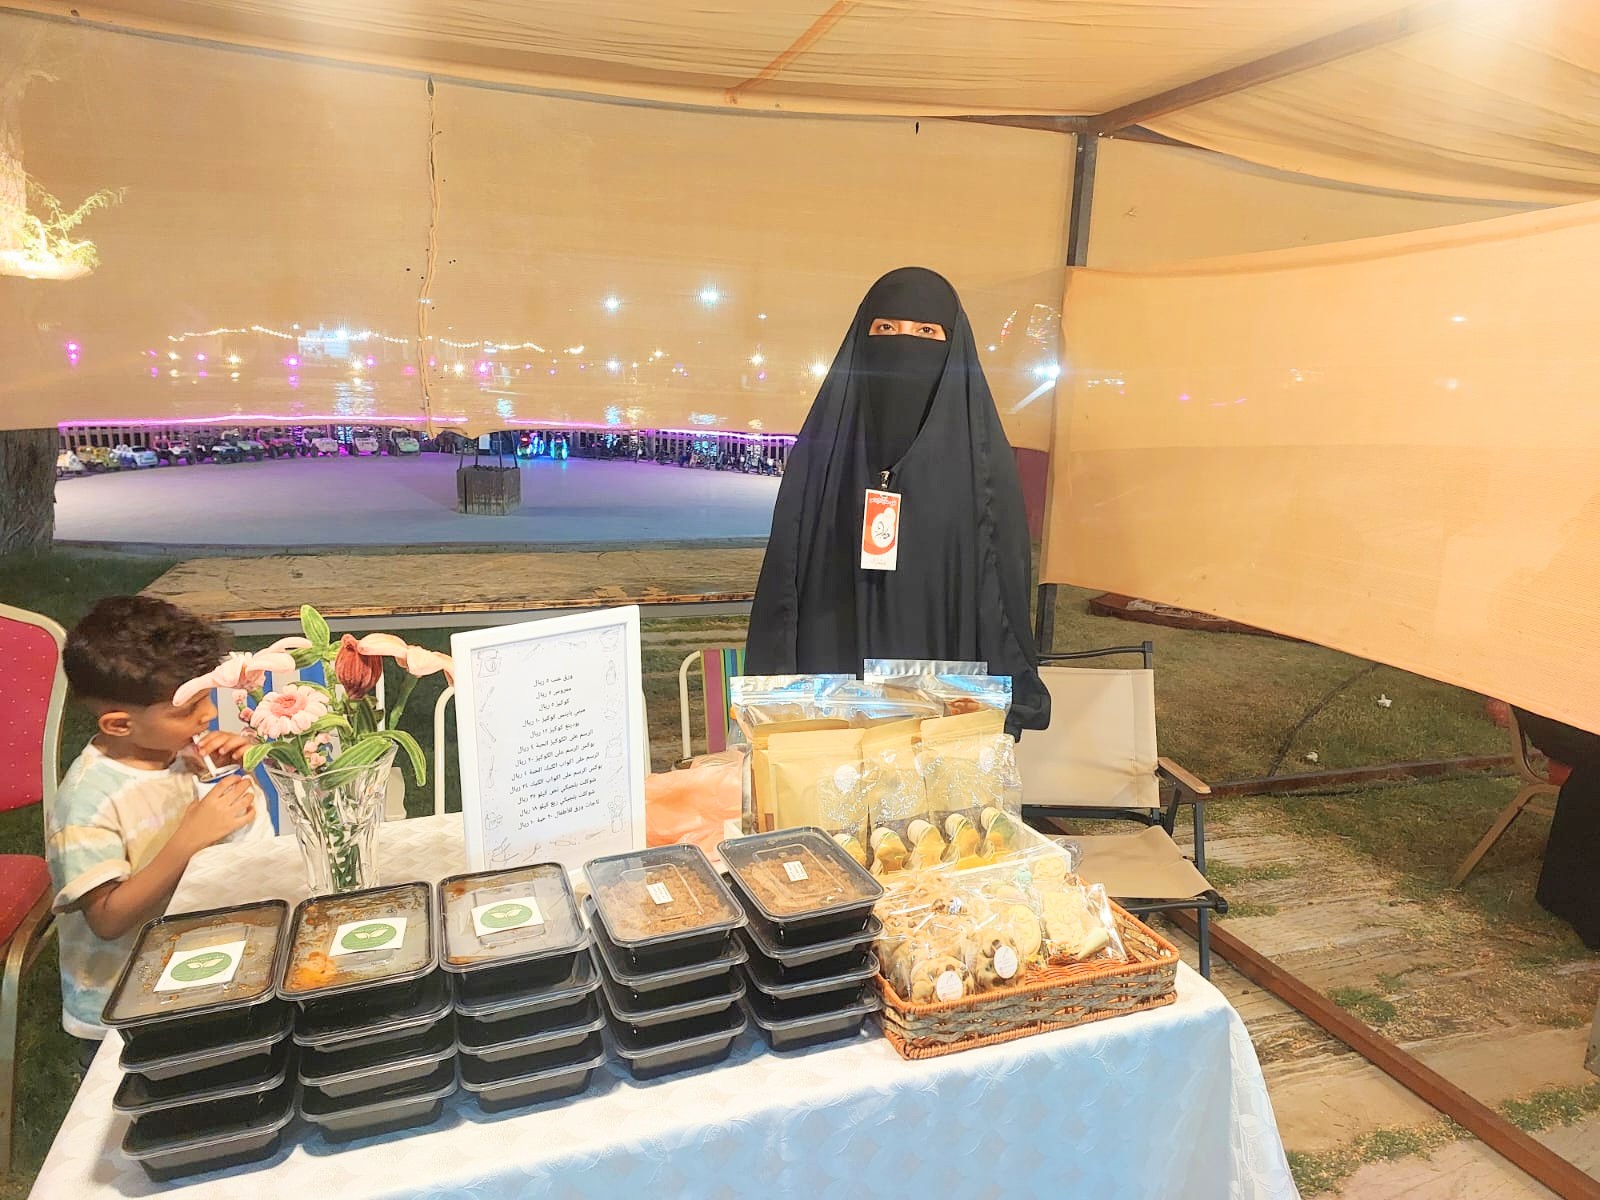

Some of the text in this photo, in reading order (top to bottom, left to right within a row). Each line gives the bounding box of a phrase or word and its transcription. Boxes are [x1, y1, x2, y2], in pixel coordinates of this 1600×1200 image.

[533, 679, 545, 687] ريال
[536, 691, 547, 699] ريال
[539, 703, 551, 711] ريال
[522, 720, 534, 728] ريال
[530, 731, 542, 739] ريال
[517, 746, 529, 754] ريال
[515, 759, 527, 767] ريال
[511, 772, 523, 781] ريال
[509, 785, 521, 794] ريال
[517, 796, 529, 805] ريال
[519, 809, 531, 817] ريال
[517, 822, 529, 830] ريال
